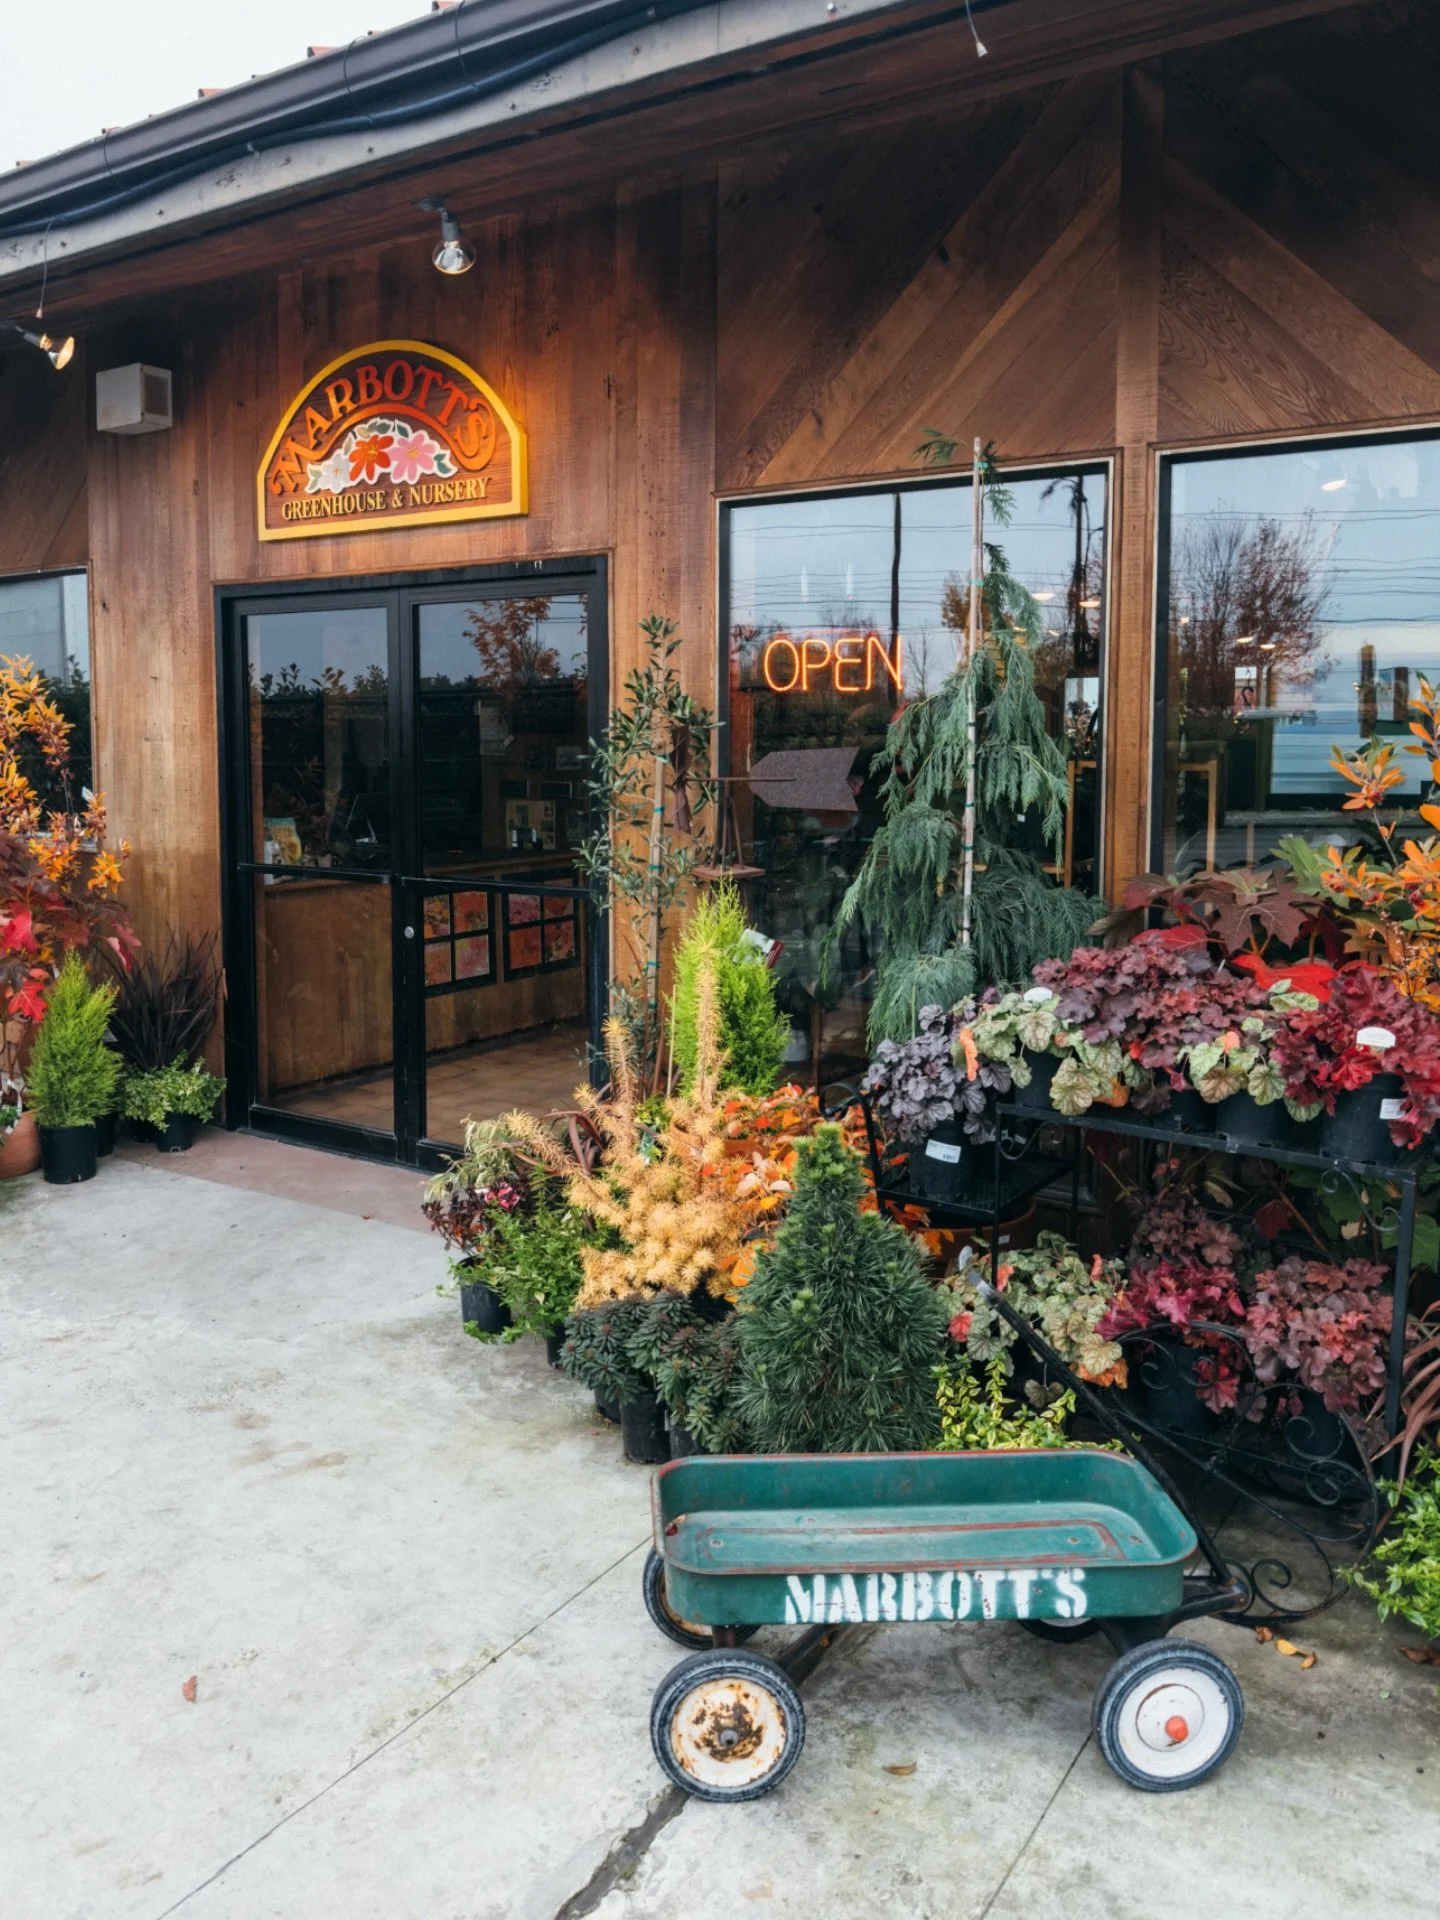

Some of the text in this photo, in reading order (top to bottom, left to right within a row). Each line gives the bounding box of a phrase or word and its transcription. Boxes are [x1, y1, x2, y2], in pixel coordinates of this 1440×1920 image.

[281, 477, 490, 521] GREENHOUSE & NURSERY
[763, 635, 904, 693] OPEN
[785, 1567, 1088, 1624] MARBOTT'S
